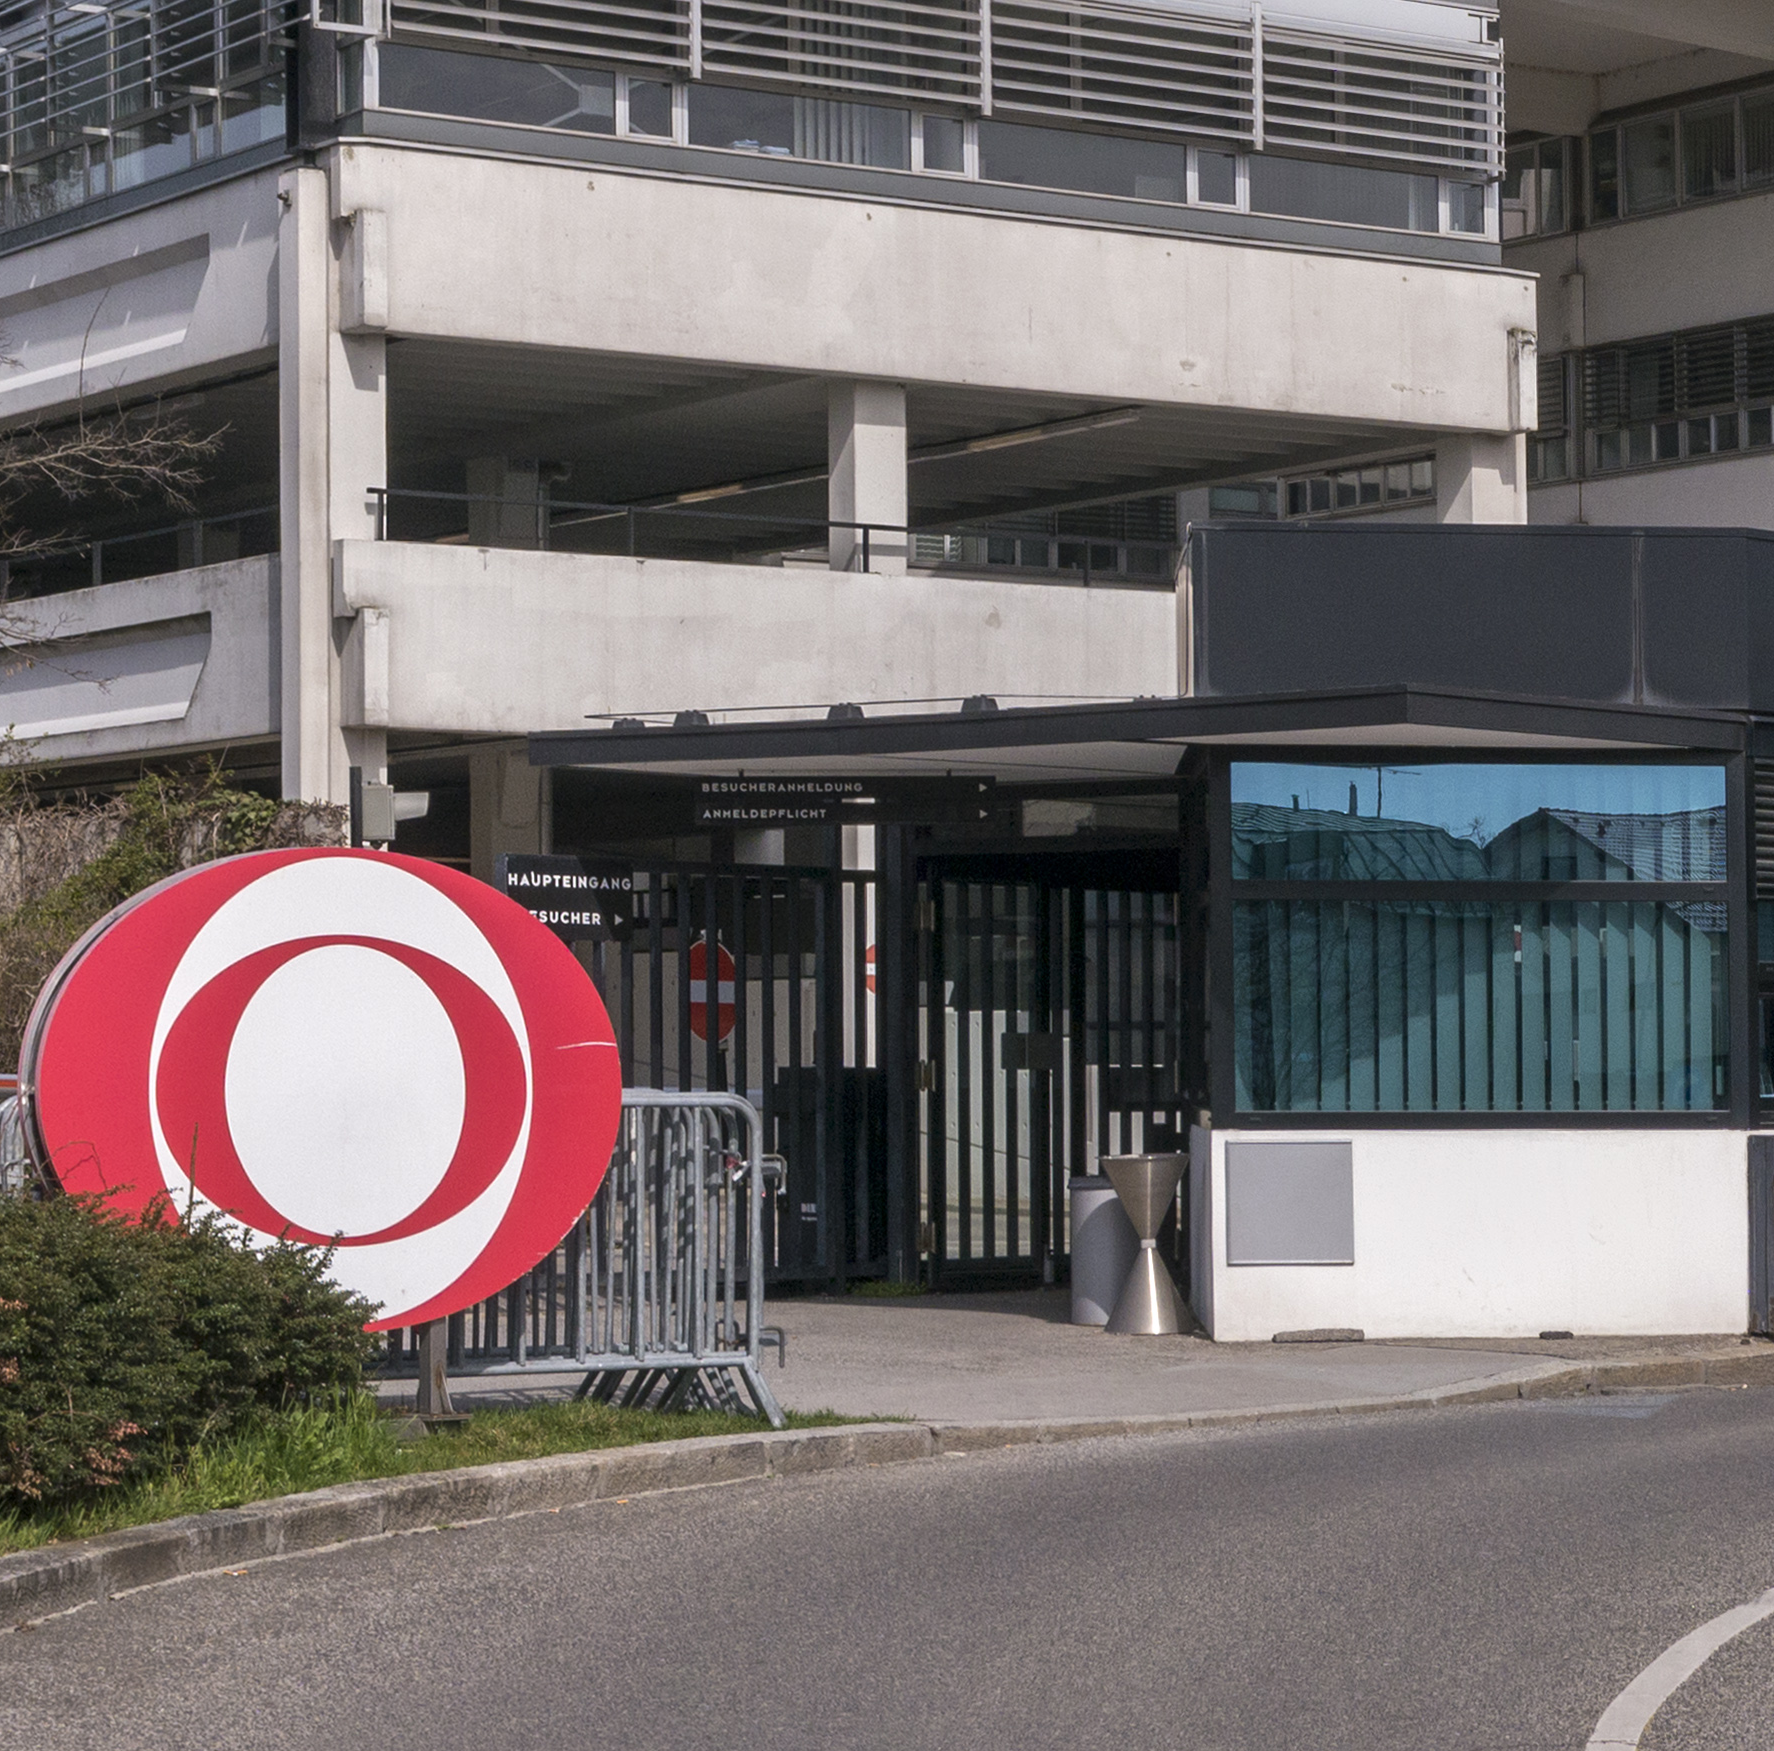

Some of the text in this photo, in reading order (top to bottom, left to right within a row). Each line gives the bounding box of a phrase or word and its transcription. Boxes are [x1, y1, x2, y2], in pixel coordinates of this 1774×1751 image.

[701, 782, 863, 793] BESUCHERANMELDUNG
[702, 809, 827, 819] ANMELDEPFLICHT
[507, 871, 632, 890] HAUPTEINGANG
